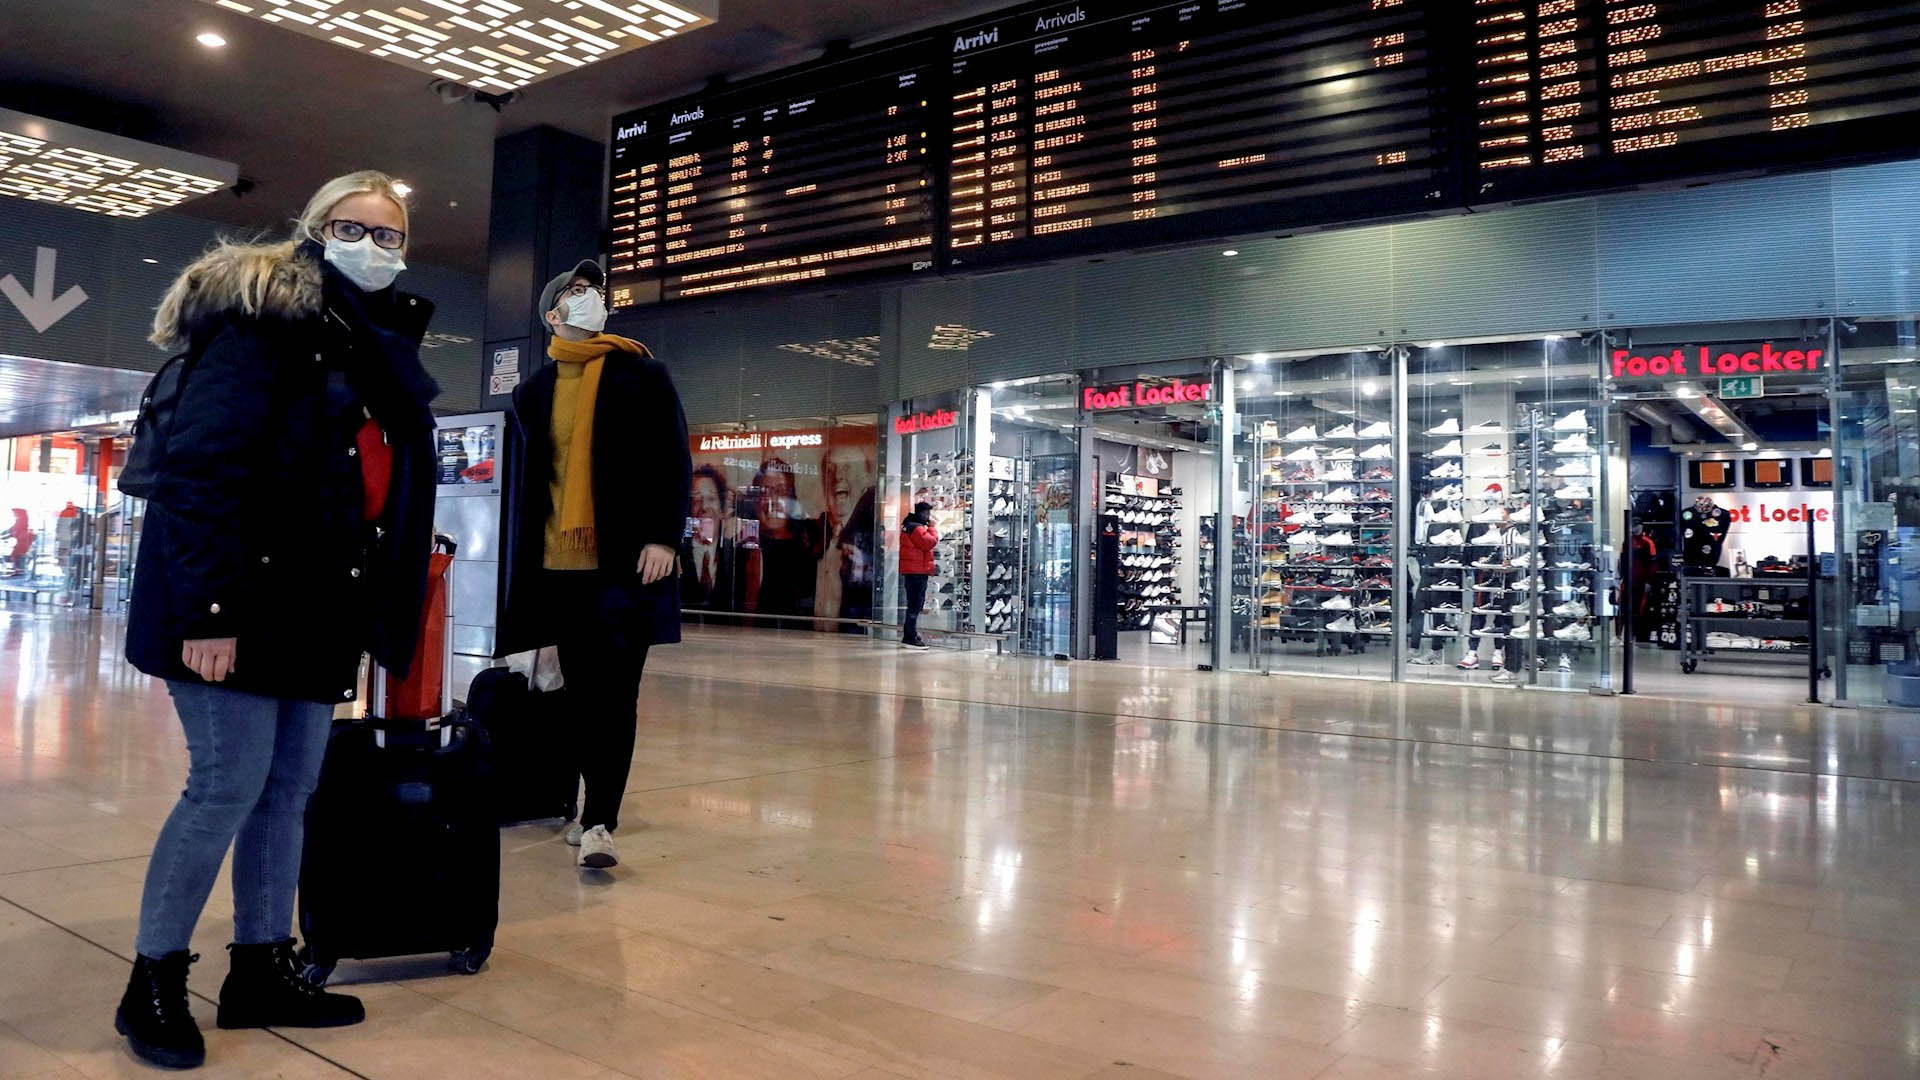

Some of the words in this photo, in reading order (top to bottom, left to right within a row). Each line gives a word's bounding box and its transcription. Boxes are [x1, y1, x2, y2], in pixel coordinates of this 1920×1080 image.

[1035, 6, 1086, 32] Arrivals
[953, 27, 999, 52] Arrivi
[670, 106, 704, 126] Arrivals
[617, 121, 647, 140] Arrivi
[1612, 349, 1687, 377] Foot
[1700, 343, 1823, 375] Locker
[1084, 386, 1130, 411] Foot
[1135, 379, 1212, 406] Locker
[895, 416, 916, 434] Foot
[920, 409, 957, 431] Locker
[769, 434, 822, 450] express
[1729, 505, 1750, 522] ot
